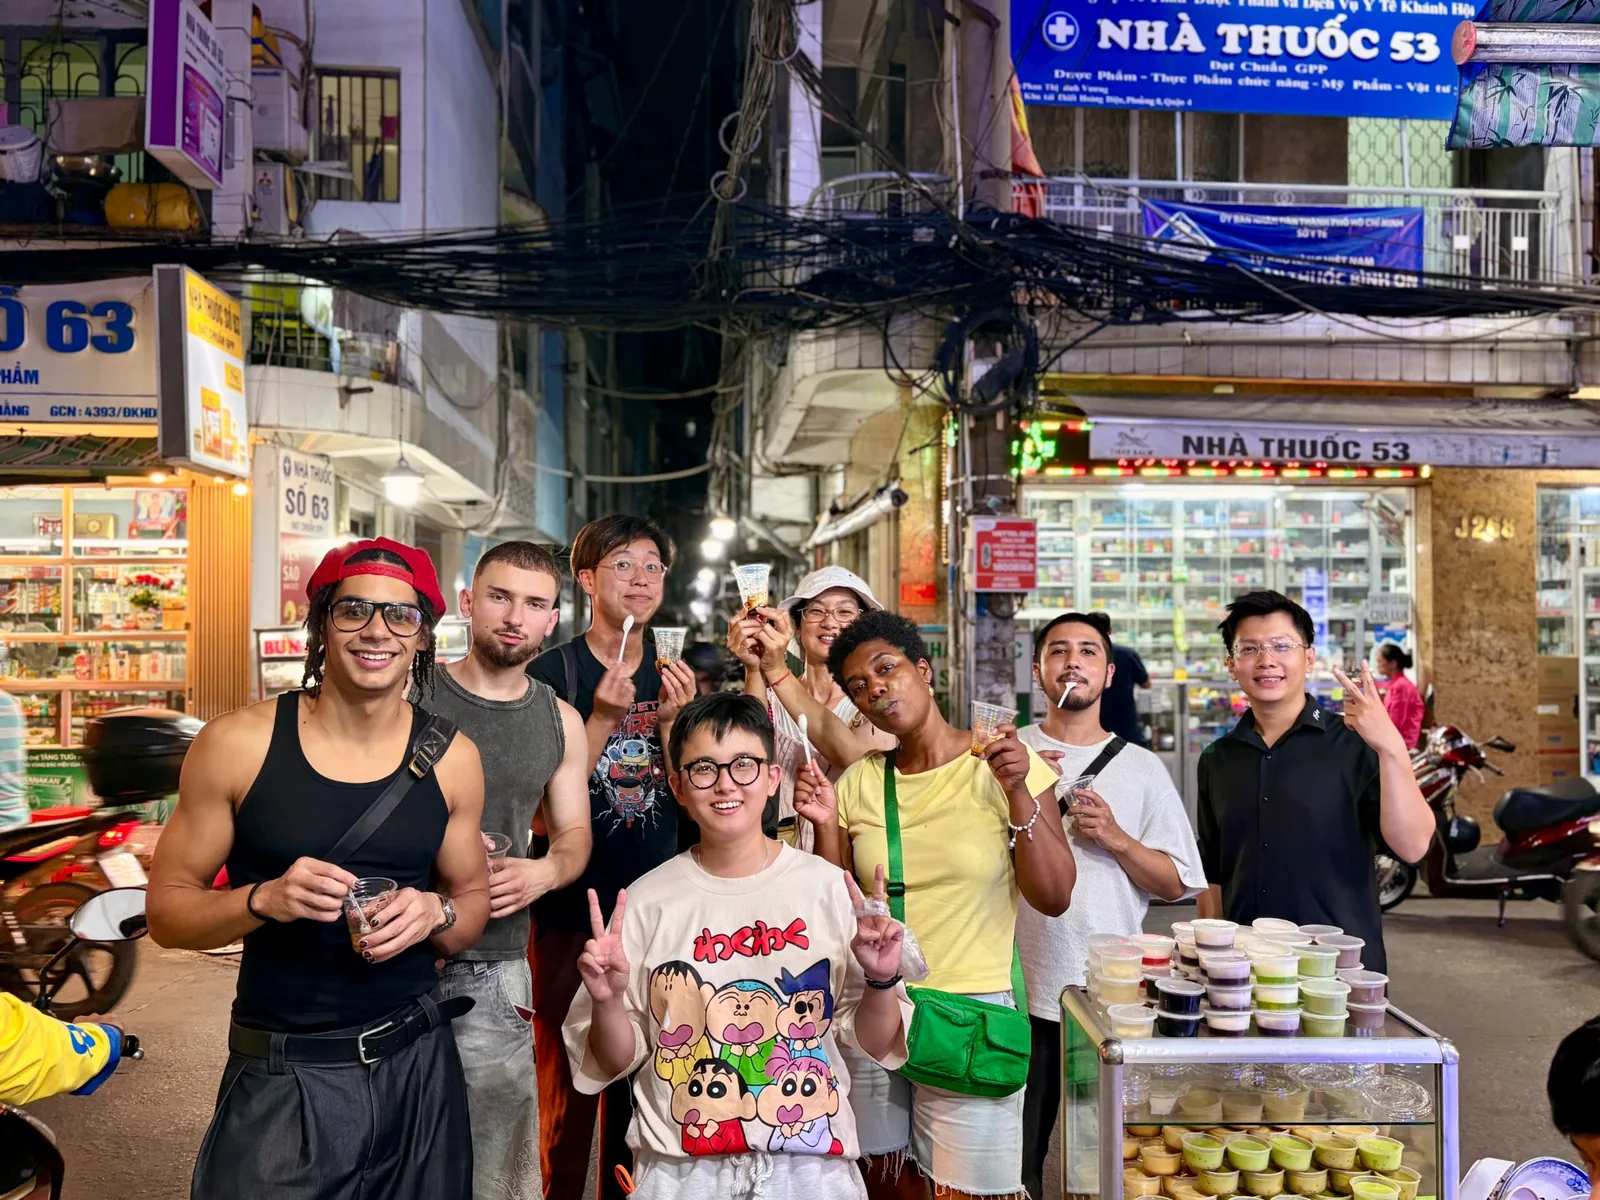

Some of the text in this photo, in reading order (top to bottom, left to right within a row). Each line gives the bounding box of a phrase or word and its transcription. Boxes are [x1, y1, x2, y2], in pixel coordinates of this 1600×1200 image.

[1401, 0, 1449, 15] Khánh
[1452, 1, 1476, 19] Hội
[1097, 12, 1441, 63] NHÀ THUỐC 53
[1210, 60, 1329, 75] Đạt Chuẩn GPP
[1098, 70, 1138, 83] Phẩm
[1151, 72, 1187, 85] Thực
[1193, 73, 1233, 86] Phẩm
[1238, 76, 1271, 87] chức
[1276, 78, 1309, 90] năng
[1321, 79, 1345, 91] Mỹ
[1353, 78, 1392, 91] Phẩm
[1406, 82, 1430, 94] Vật
[46, 300, 136, 354] 63
[0, 361, 40, 385] HẨM
[50, 406, 77, 418] GCN
[1182, 432, 1249, 457] NHÀ
[1258, 432, 1362, 460] THUỐC
[1372, 441, 1411, 462] 53
[294, 459, 333, 487] NHÀ THUỐC
[285, 482, 330, 521] SỐ 63
[40, 753, 59, 761] TĂNG
[693, 917, 810, 964] わくわく
